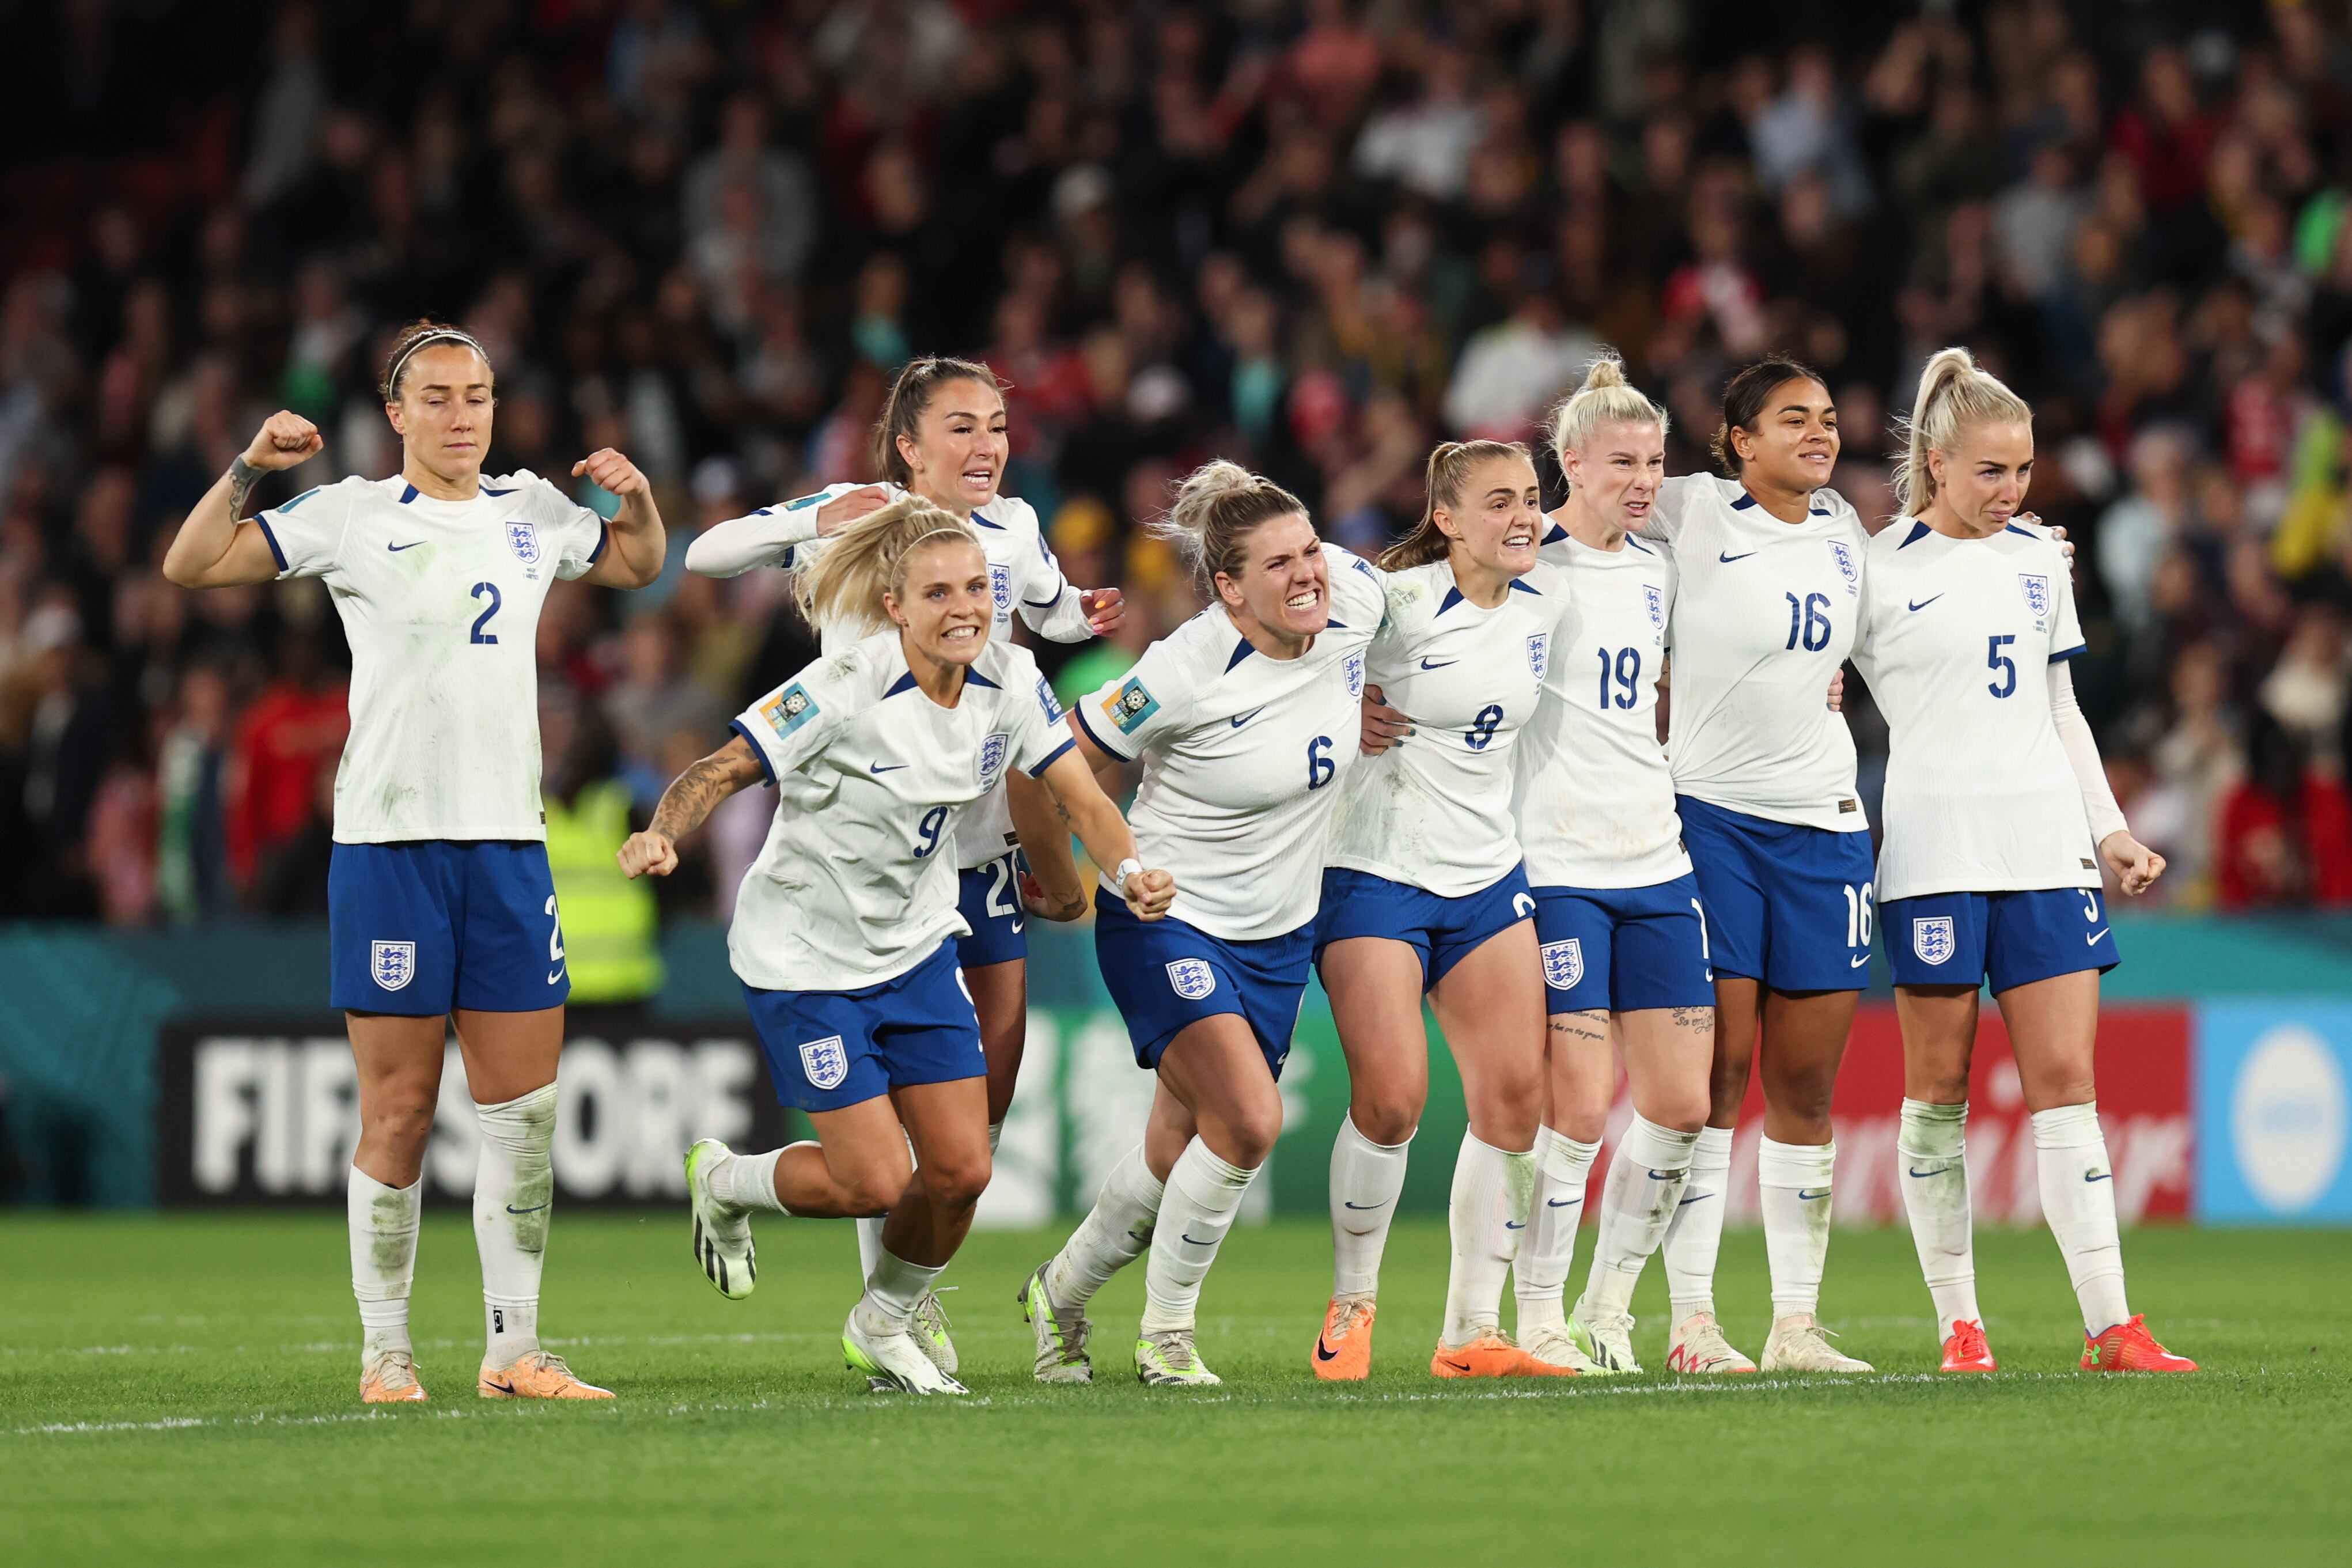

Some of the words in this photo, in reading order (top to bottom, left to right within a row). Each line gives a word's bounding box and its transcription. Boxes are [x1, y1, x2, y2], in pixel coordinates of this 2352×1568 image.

[471, 582, 501, 645] 2
[1786, 592, 1831, 652] 16
[1598, 647, 1641, 710] 19
[1988, 635, 2016, 699] 5
[1465, 705, 1503, 750] 8
[1308, 736, 1335, 790] 6
[913, 806, 948, 858] 9
[544, 894, 565, 962] 2
[1843, 882, 1872, 947] 16
[191, 1039, 369, 1194] FIF
